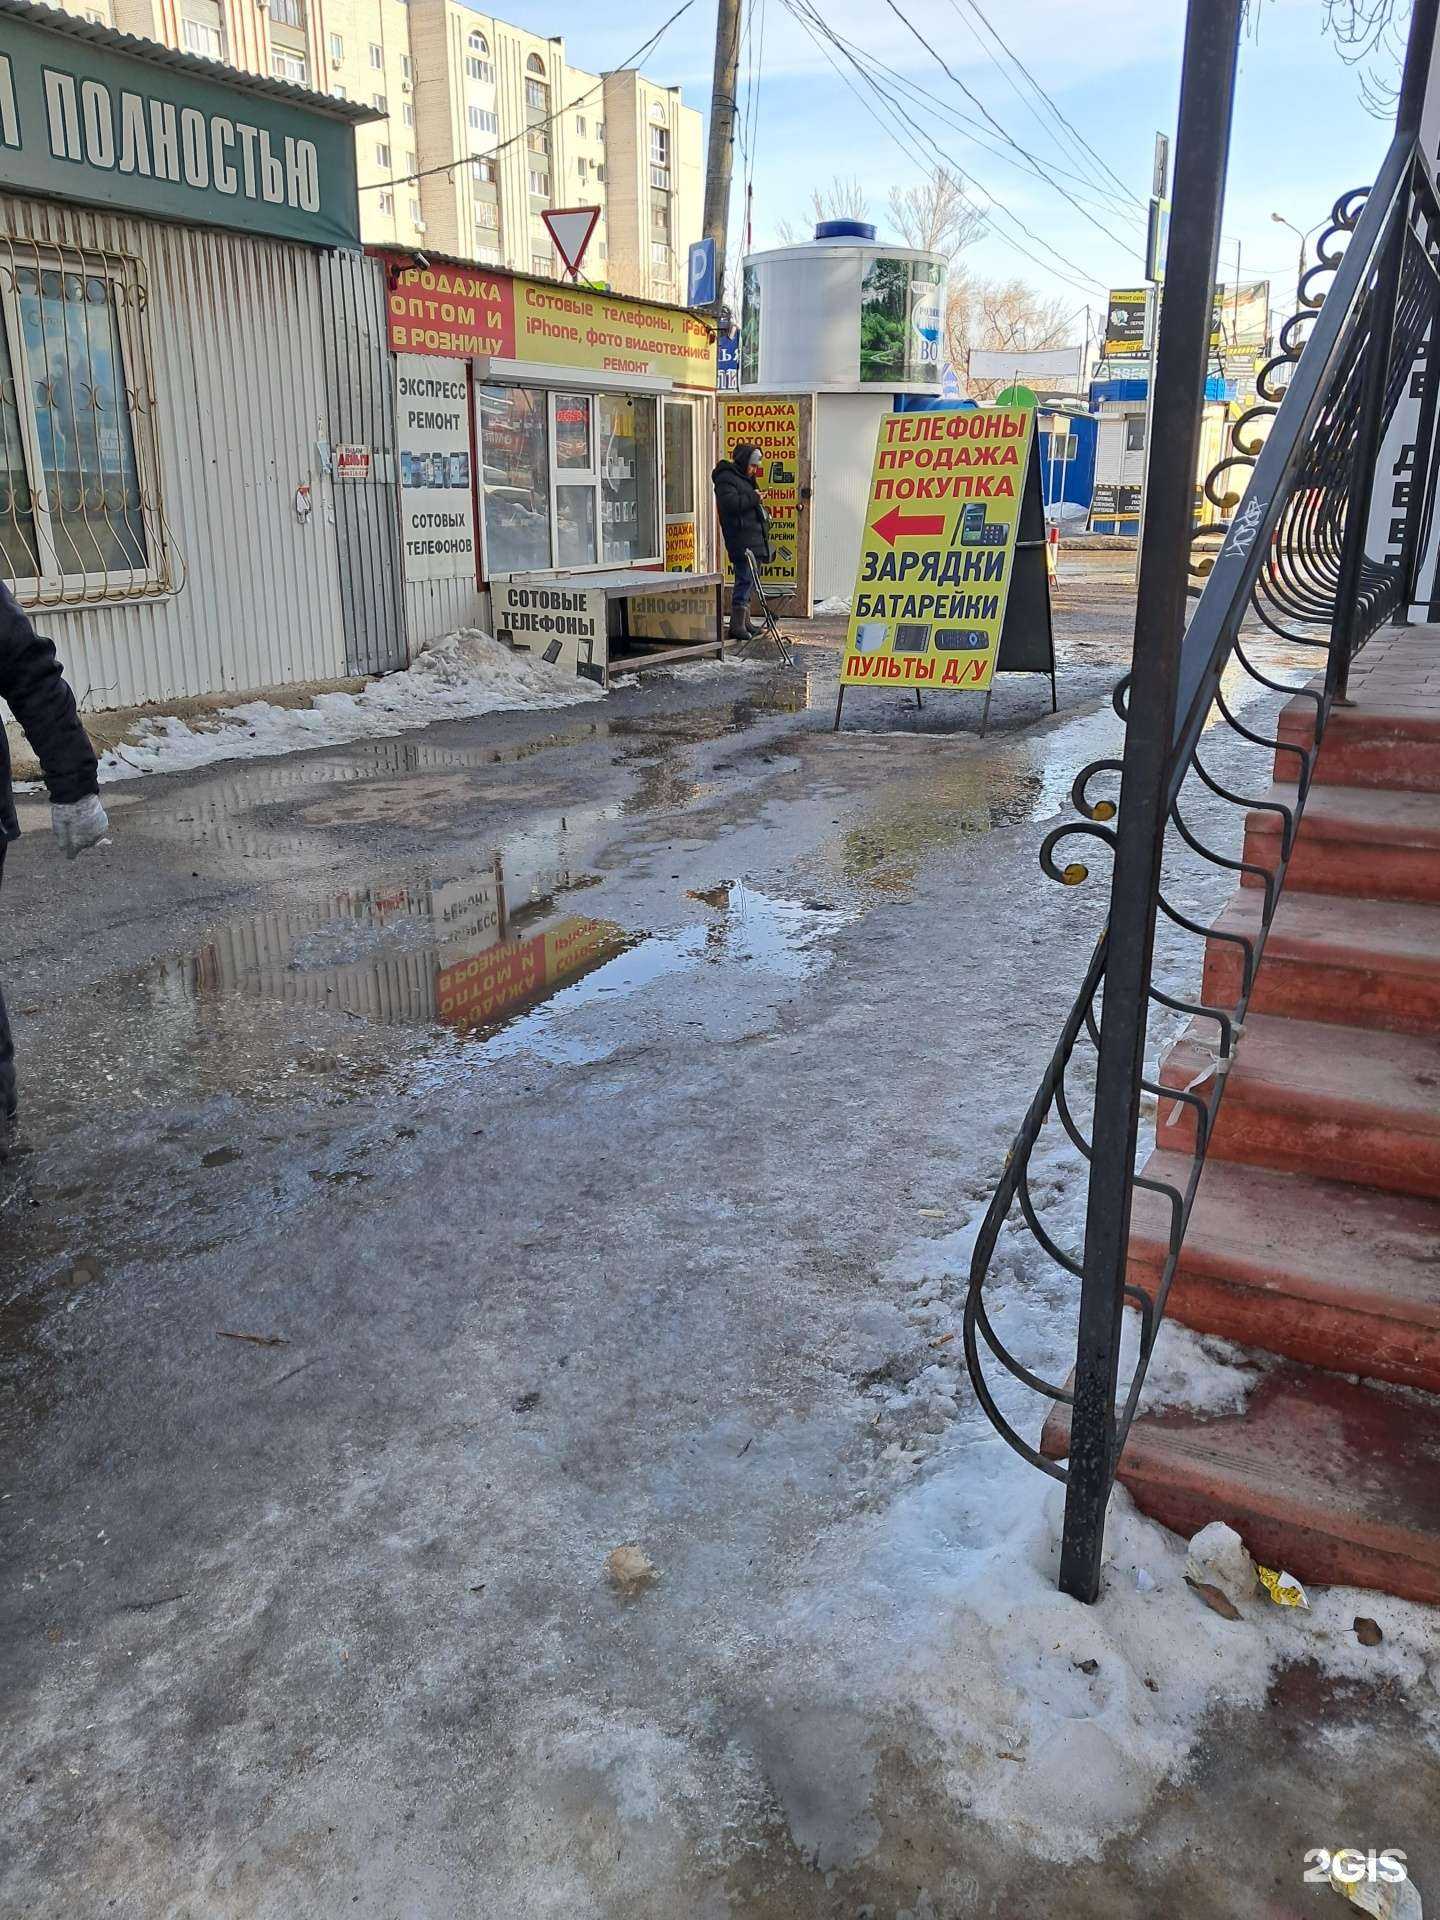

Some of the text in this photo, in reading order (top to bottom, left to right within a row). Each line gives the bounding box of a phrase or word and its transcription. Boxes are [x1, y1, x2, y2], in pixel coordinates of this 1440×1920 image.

[43, 68, 320, 213] ПОЛНОСТЬЮ
[390, 295, 502, 329] ОПТОМ И
[525, 288, 593, 316] Сотовые
[602, 306, 674, 333] телефоны,
[392, 325, 503, 355] В РОЗНИЦУ
[526, 317, 711, 361] iPhone, фото видеотехника
[603, 357, 649, 374] РЕМОНТ
[399, 377, 466, 400] ЭКСПРЕСС
[408, 411, 460, 430] РЕМОНТ
[727, 405, 795, 417] ПРОДАЖА
[727, 420, 795, 432] ПОКУПКА
[886, 413, 1026, 443] ТЕЛЕФОНЫ
[727, 436, 795, 447] СОТОВЫХ
[727, 450, 795, 460] ТОНОВ
[878, 446, 1019, 471] ПРОДАЖА
[874, 476, 1014, 500] ПОКУПКА
[411, 513, 465, 529] СОТОВЫХ
[406, 538, 472, 556] ТЕЛЕФОНОВ
[861, 551, 1006, 587] ЗАРЯДКИ
[508, 589, 587, 612] СОТОВЫЕ
[856, 591, 999, 620] БАТАРЕЙКИ
[501, 611, 595, 637] ТЕЛЕФОНЫ
[846, 656, 989, 684] ПУЛЬТЫ Д/У
